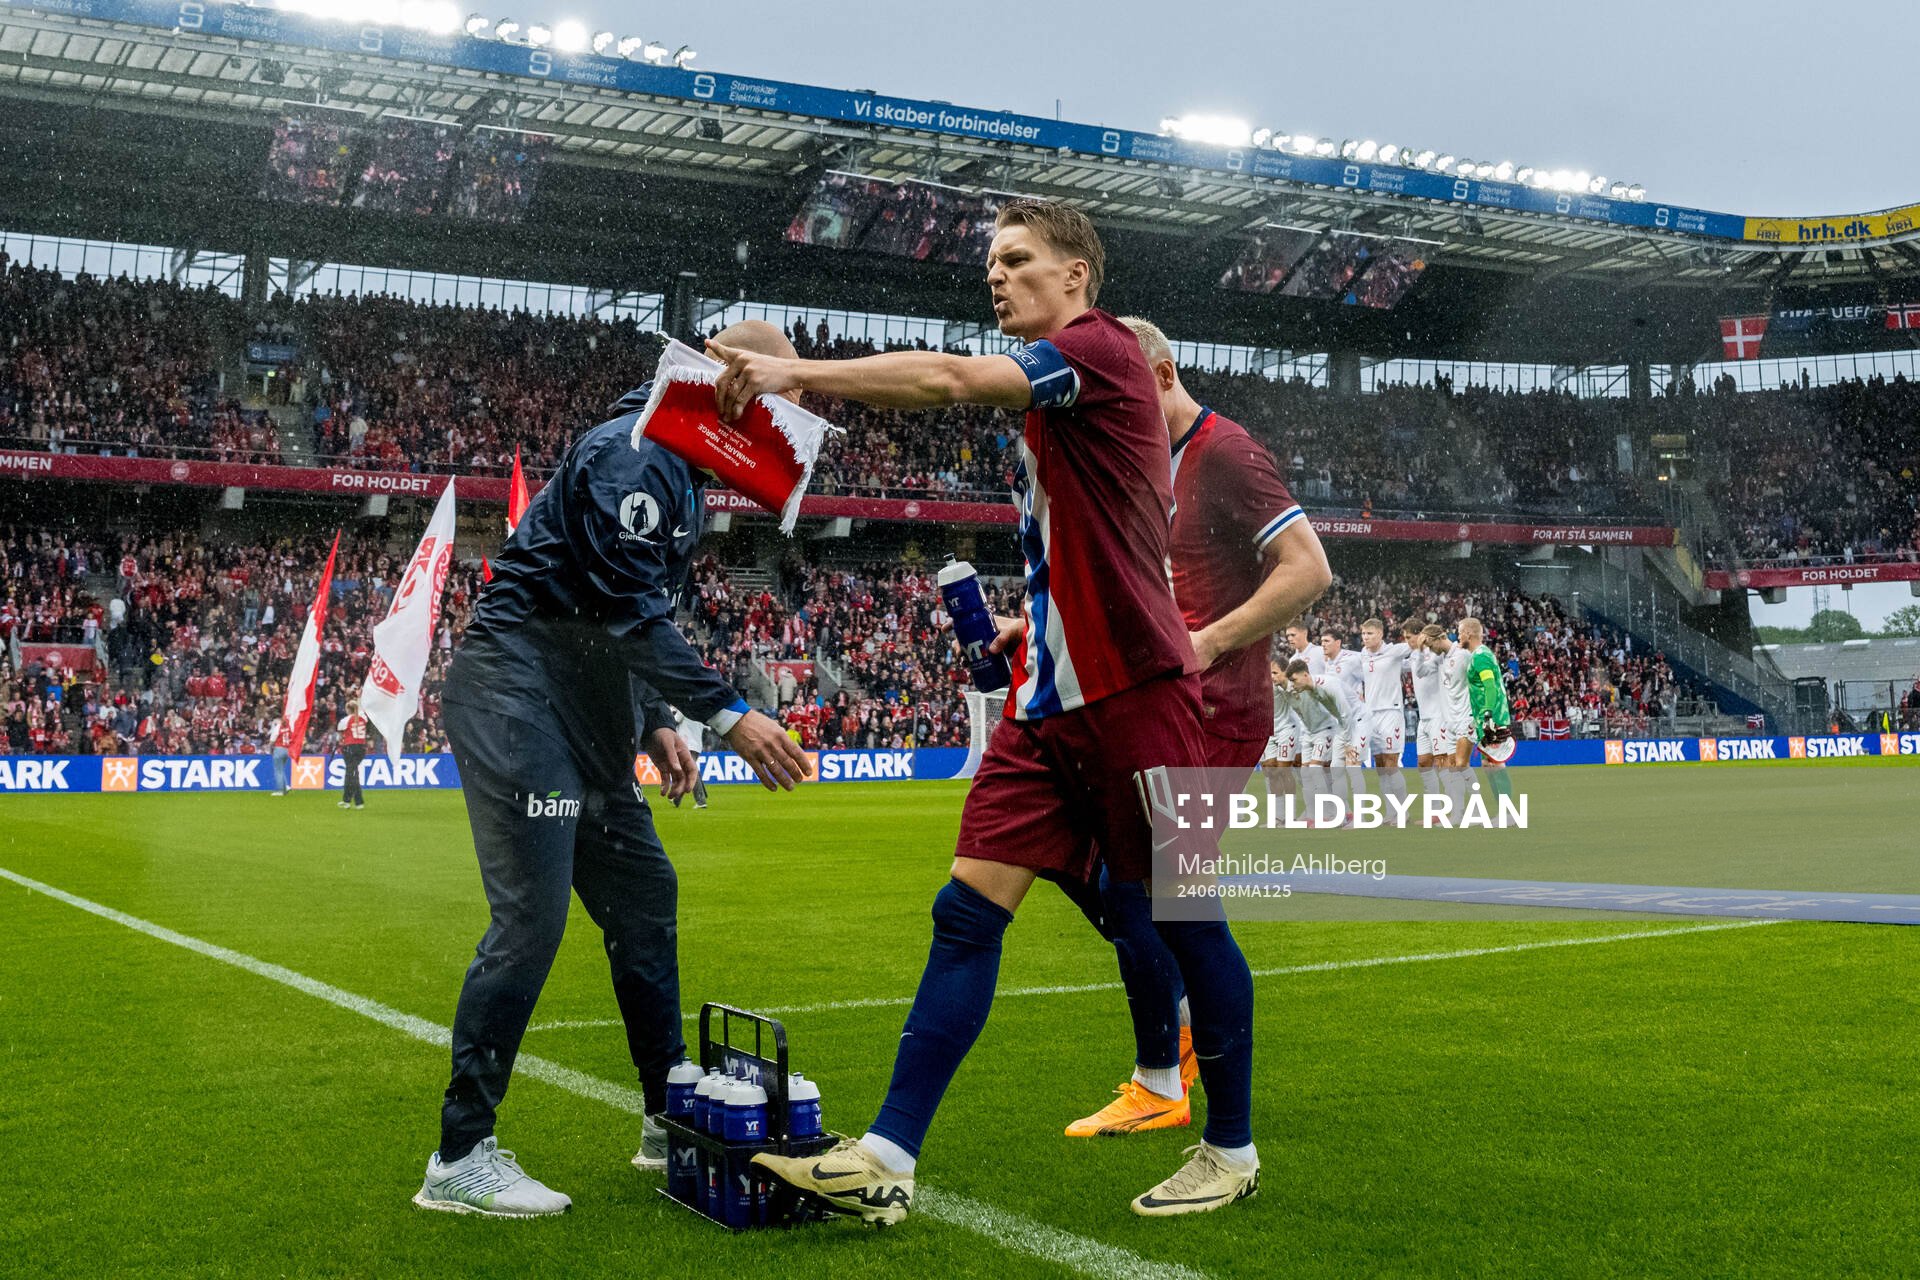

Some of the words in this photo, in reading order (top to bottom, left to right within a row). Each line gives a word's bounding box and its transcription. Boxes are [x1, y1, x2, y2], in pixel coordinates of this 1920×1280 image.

[854, 100, 871, 117] Vi
[875, 104, 935, 125] skaber
[939, 111, 1041, 139] forbindelser
[1798, 221, 1872, 240] hrh.dk
[1886, 218, 1912, 233] HRH
[1756, 230, 1780, 240] HRH
[697, 423, 721, 443] NORGE
[723, 442, 757, 469] DANMARK
[332, 474, 364, 488] FOR
[368, 476, 430, 491] HOLDET
[704, 495, 726, 506] OR
[1311, 522, 1331, 532] FOR
[1333, 523, 1372, 533] SEJREN
[1533, 529, 1553, 540] FOR
[1553, 530, 1566, 539] AT
[1568, 529, 1586, 540] STÅ
[1588, 530, 1632, 541] SAMMEN
[1802, 571, 1826, 581] FOR
[1830, 568, 1878, 579] HOLDET
[1386, 737, 1392, 750] 9
[1624, 741, 1686, 763] STARK
[1717, 739, 1776, 760] STARK
[1806, 736, 1866, 757] STARK
[140, 759, 261, 789] STARK
[821, 752, 913, 778] STARK
[745, 1120, 759, 1131] YT
